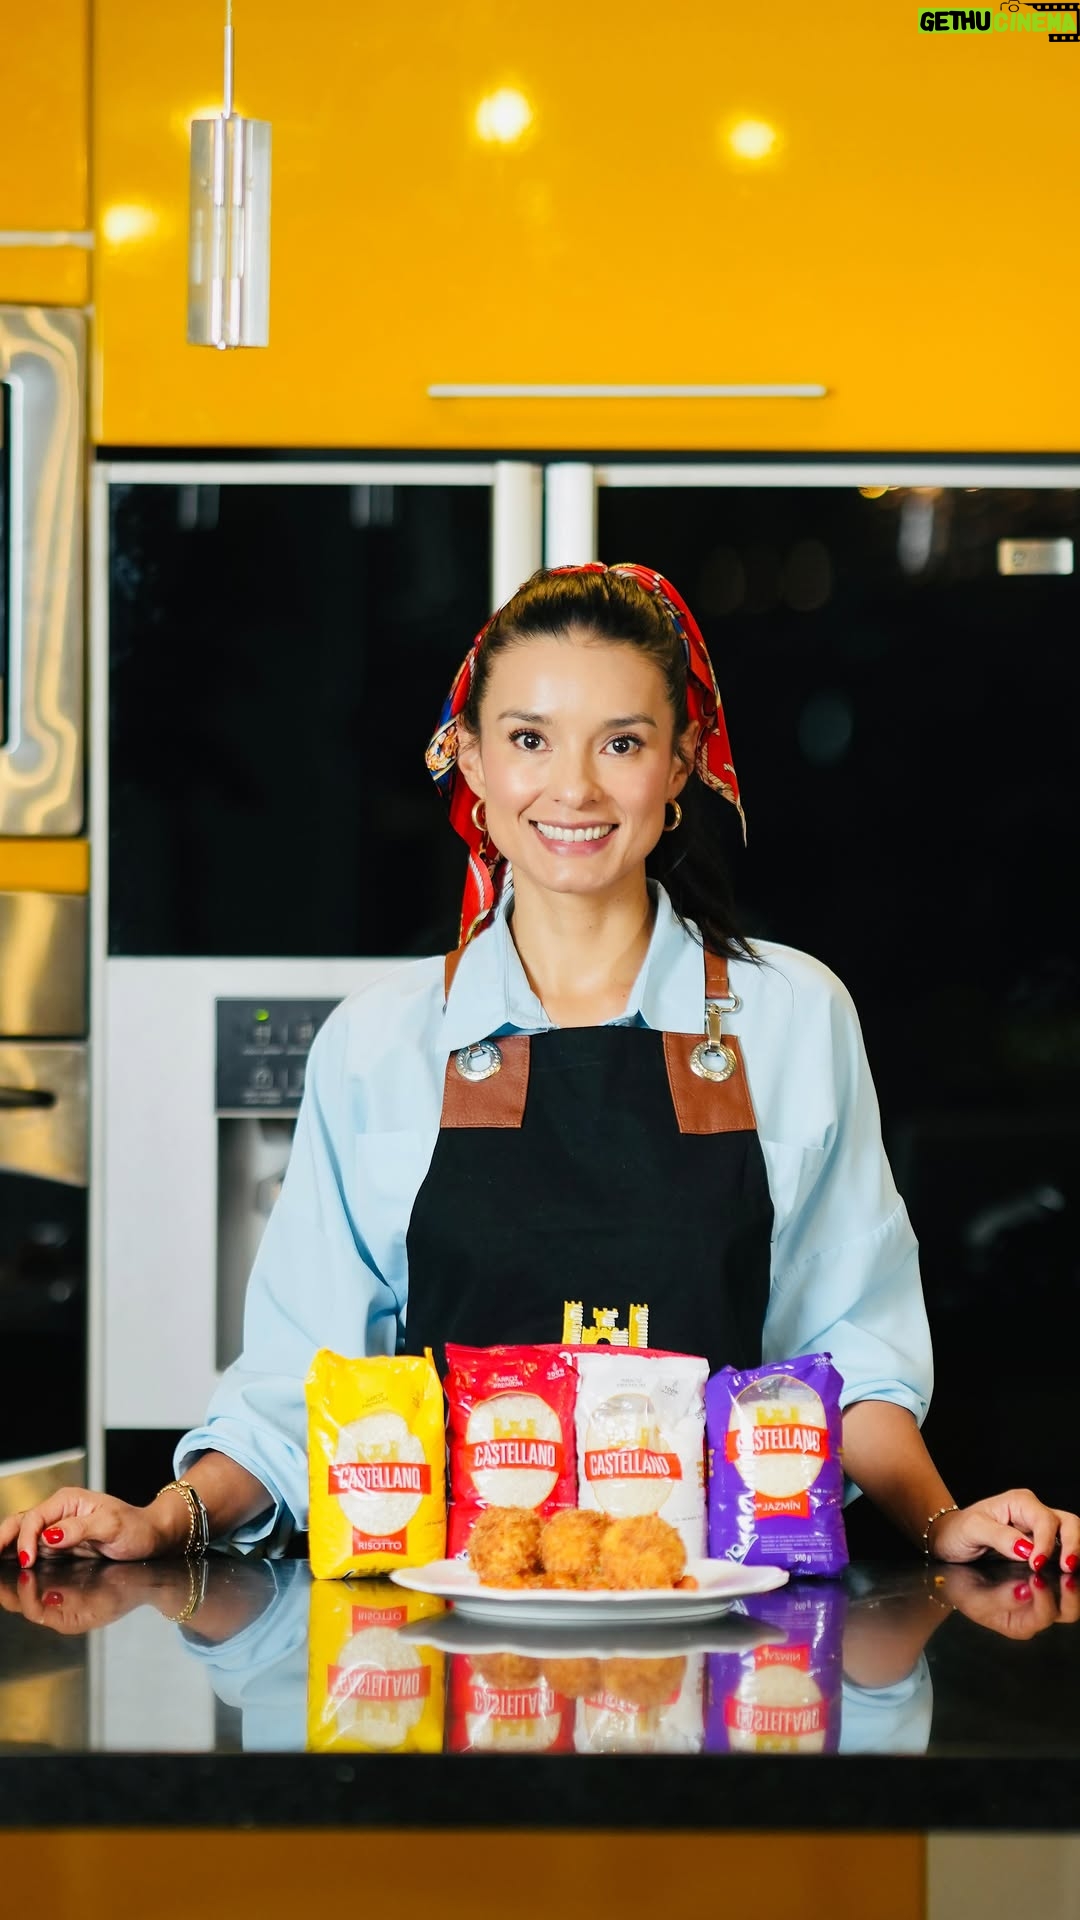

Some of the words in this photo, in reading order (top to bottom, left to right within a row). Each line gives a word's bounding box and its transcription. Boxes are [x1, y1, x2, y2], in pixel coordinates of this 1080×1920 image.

[735, 1427, 820, 1454] CSTELLANO
[474, 1442, 556, 1467] CASTELLANO
[589, 1451, 670, 1476] CASTELLANO
[338, 1466, 420, 1490] CASTELLANO
[762, 1499, 801, 1512] JAZMÍN
[358, 1540, 402, 1551] RISOTTO
